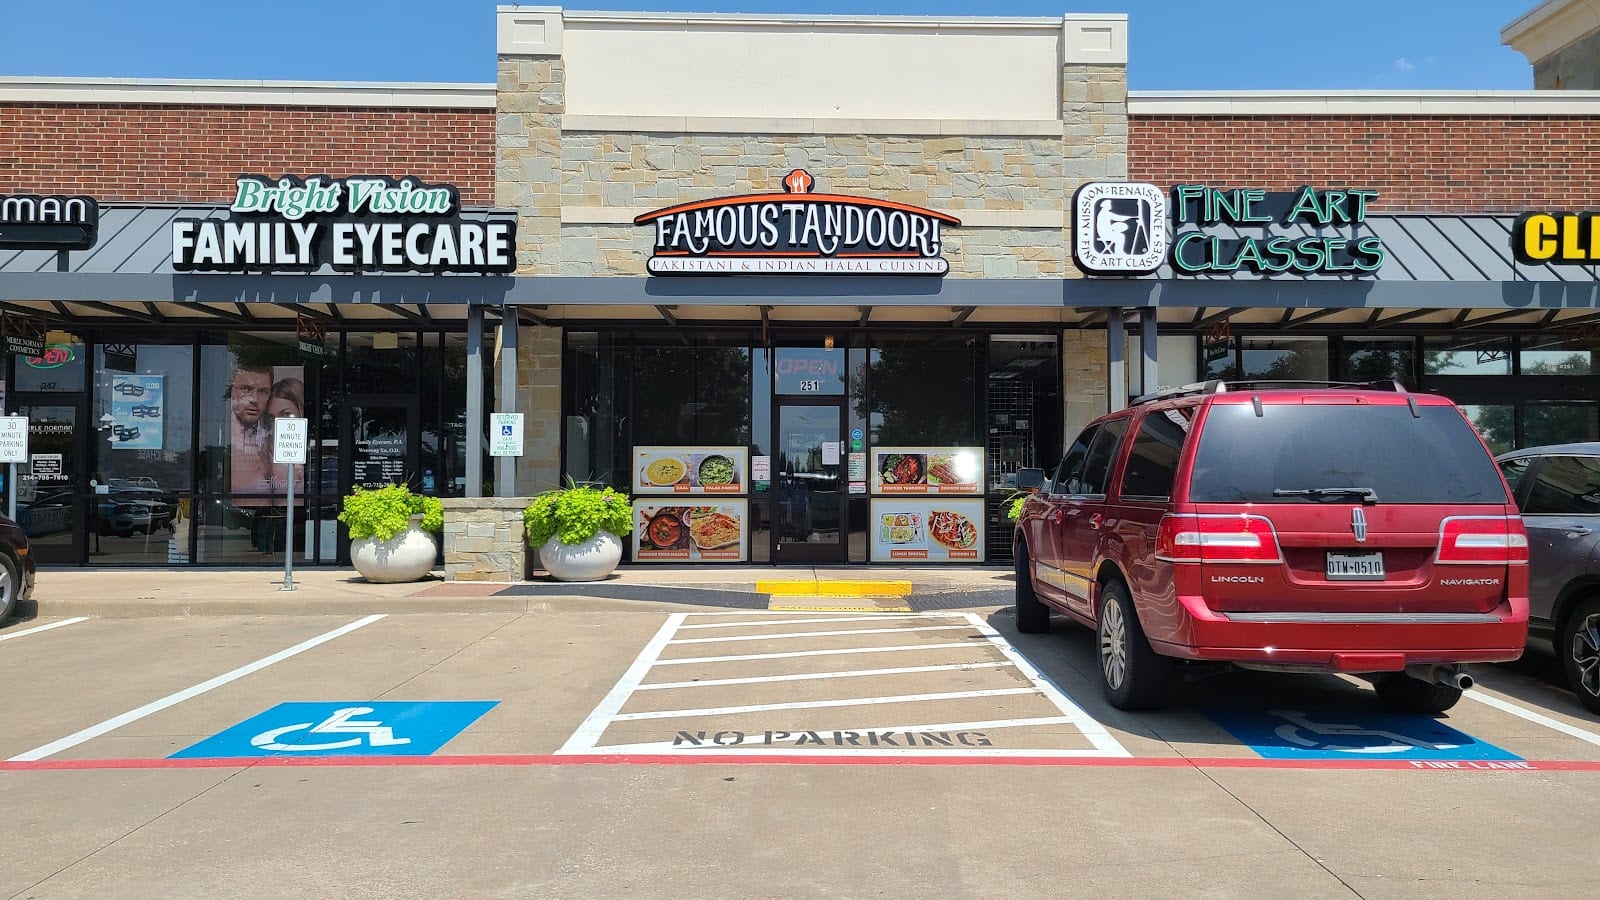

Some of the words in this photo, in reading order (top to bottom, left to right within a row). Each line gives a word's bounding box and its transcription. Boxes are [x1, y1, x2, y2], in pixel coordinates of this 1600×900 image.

[232, 178, 341, 219] Bright
[346, 178, 450, 214] Vision
[1177, 184, 1272, 222] FINE
[1287, 185, 1379, 223] ART
[0, 198, 86, 221] MAN
[656, 204, 778, 254] FAMOUS
[783, 203, 940, 256] TANDOORI
[173, 222, 318, 264] FAMILY
[333, 223, 508, 265] EYECARE
[1174, 232, 1385, 271] CLASSES
[1081, 240, 1097, 265] FINE
[1100, 258, 1122, 266] ART
[1125, 240, 1162, 267] CLASSES
[653, 260, 733, 271] PAKISTANI
[741, 261, 750, 270] &
[758, 261, 816, 271] INDIAN
[824, 261, 872, 271] HALAL
[879, 261, 943, 271] CUISINE
[9, 345, 40, 355] COSMETICS
[777, 359, 838, 375] OPEN
[801, 381, 818, 391] 251
[286, 423, 295, 431] 30
[1211, 575, 1264, 583] LINCOLN
[1440, 578, 1500, 586] NAVIGATOR
[672, 730, 744, 746] NO
[764, 730, 993, 747] PARKING
[1410, 760, 1468, 769] FIRE
[1468, 760, 1539, 770] LANE
